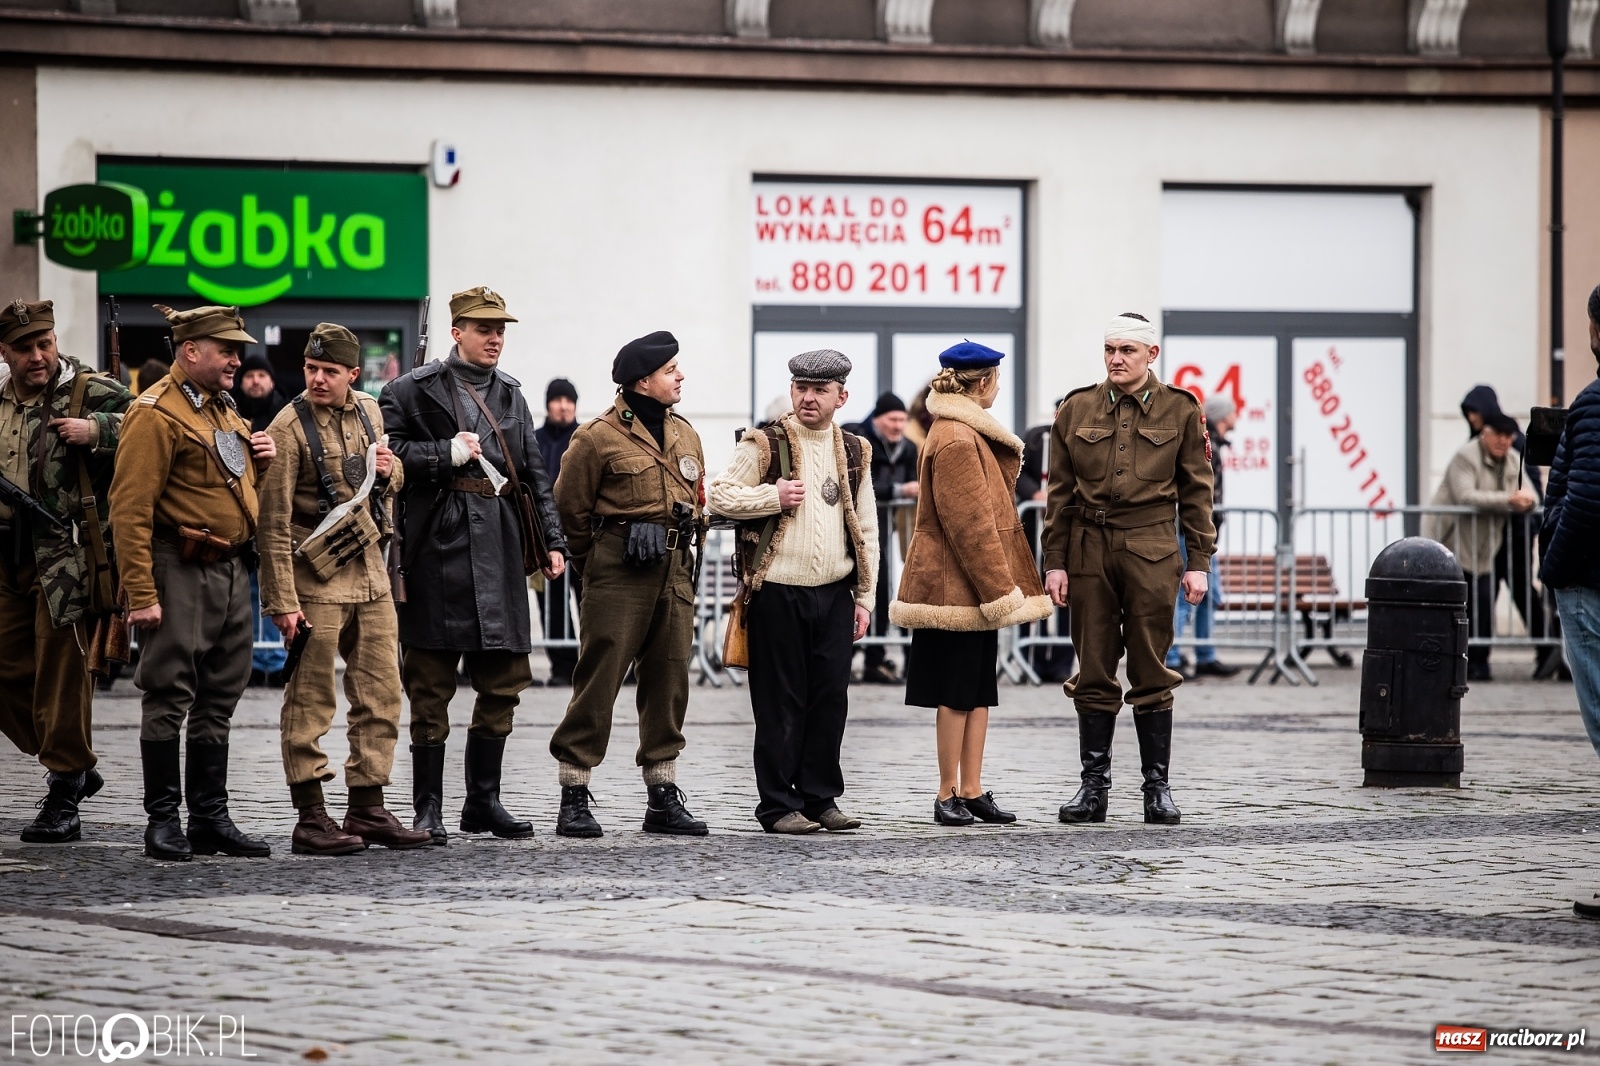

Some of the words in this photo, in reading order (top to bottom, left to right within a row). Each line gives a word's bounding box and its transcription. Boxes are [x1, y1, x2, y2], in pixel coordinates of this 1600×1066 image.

[51, 204, 126, 241] żabka
[756, 196, 855, 217] LOKAL
[869, 197, 908, 218] DO
[147, 190, 386, 271] żabka
[791, 261, 854, 292] 880
[869, 262, 928, 293] 201
[946, 263, 1006, 293] 117
[1303, 360, 1341, 417] 880
[1330, 415, 1369, 471] 201
